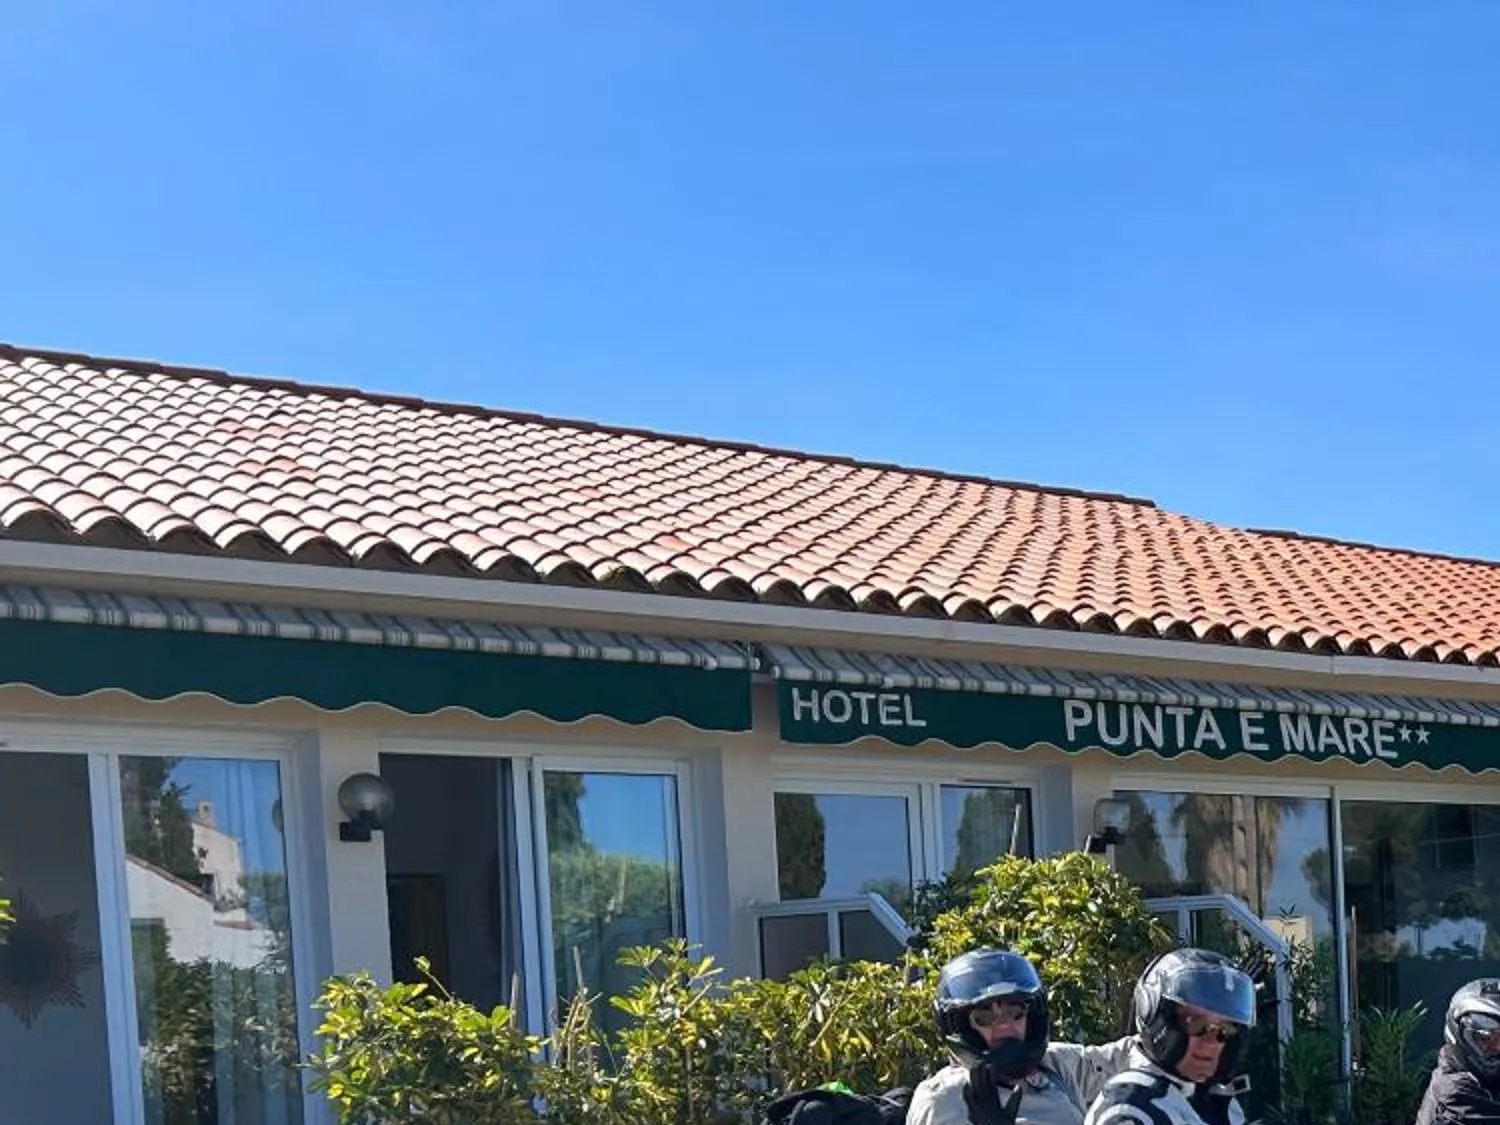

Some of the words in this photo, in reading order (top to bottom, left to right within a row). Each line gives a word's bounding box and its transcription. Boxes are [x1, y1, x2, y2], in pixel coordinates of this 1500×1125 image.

[791, 687, 927, 727] HOTEL
[1063, 699, 1227, 749] PUNTA
[1239, 711, 1270, 751] E
[1279, 713, 1398, 759] MARE
